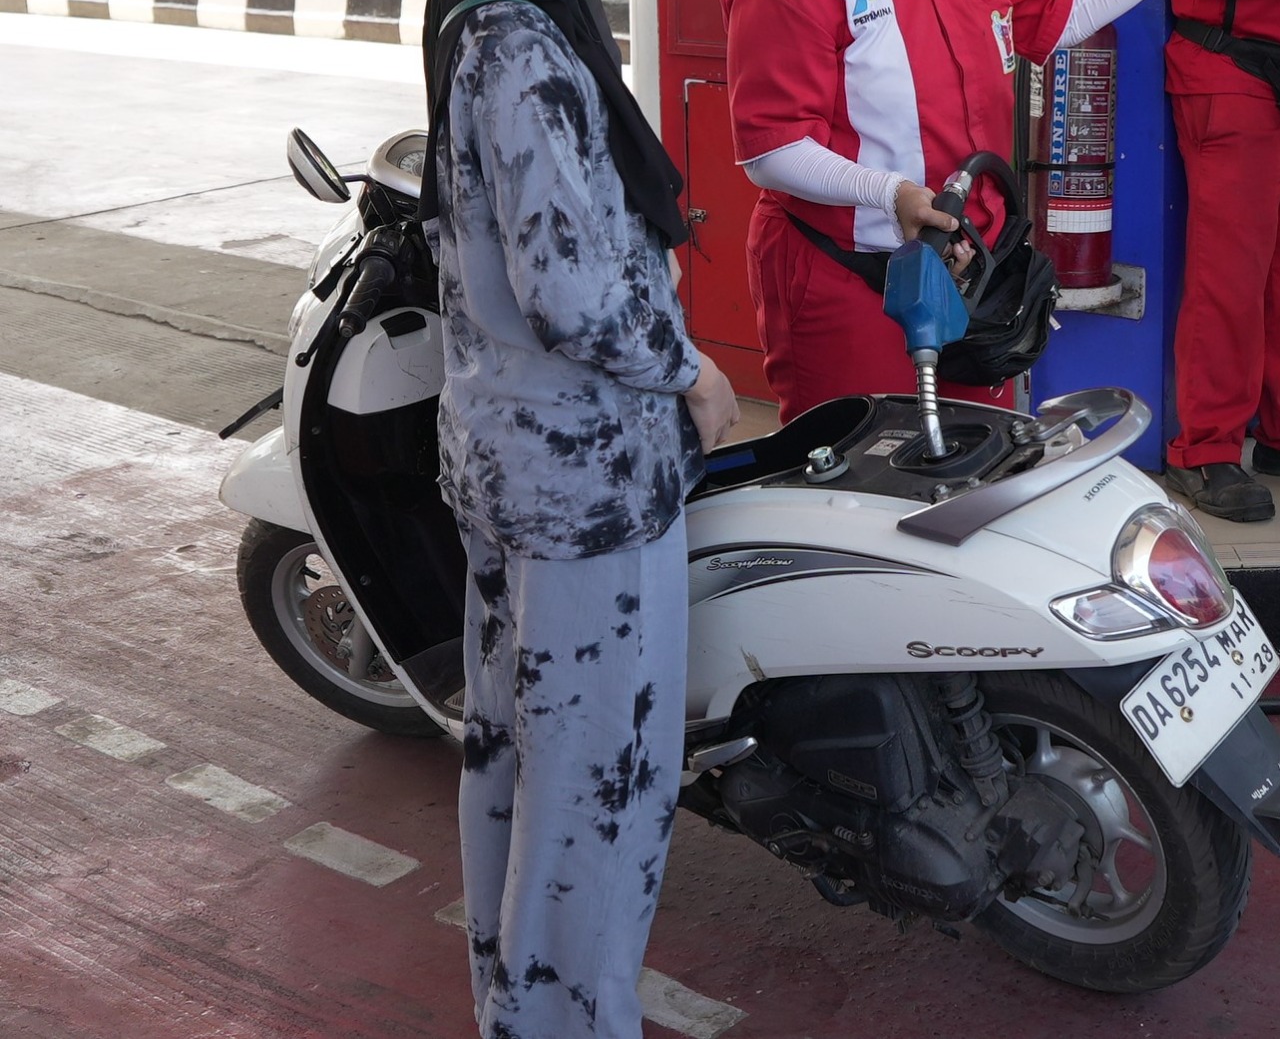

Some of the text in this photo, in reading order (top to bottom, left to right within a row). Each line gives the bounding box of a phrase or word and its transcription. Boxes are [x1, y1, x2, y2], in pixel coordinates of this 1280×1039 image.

[1083, 473, 1117, 501] HONDA
[707, 557, 794, 570] Scoopylicious
[1131, 691, 1174, 741] DA
[1160, 641, 1222, 707] 6254
